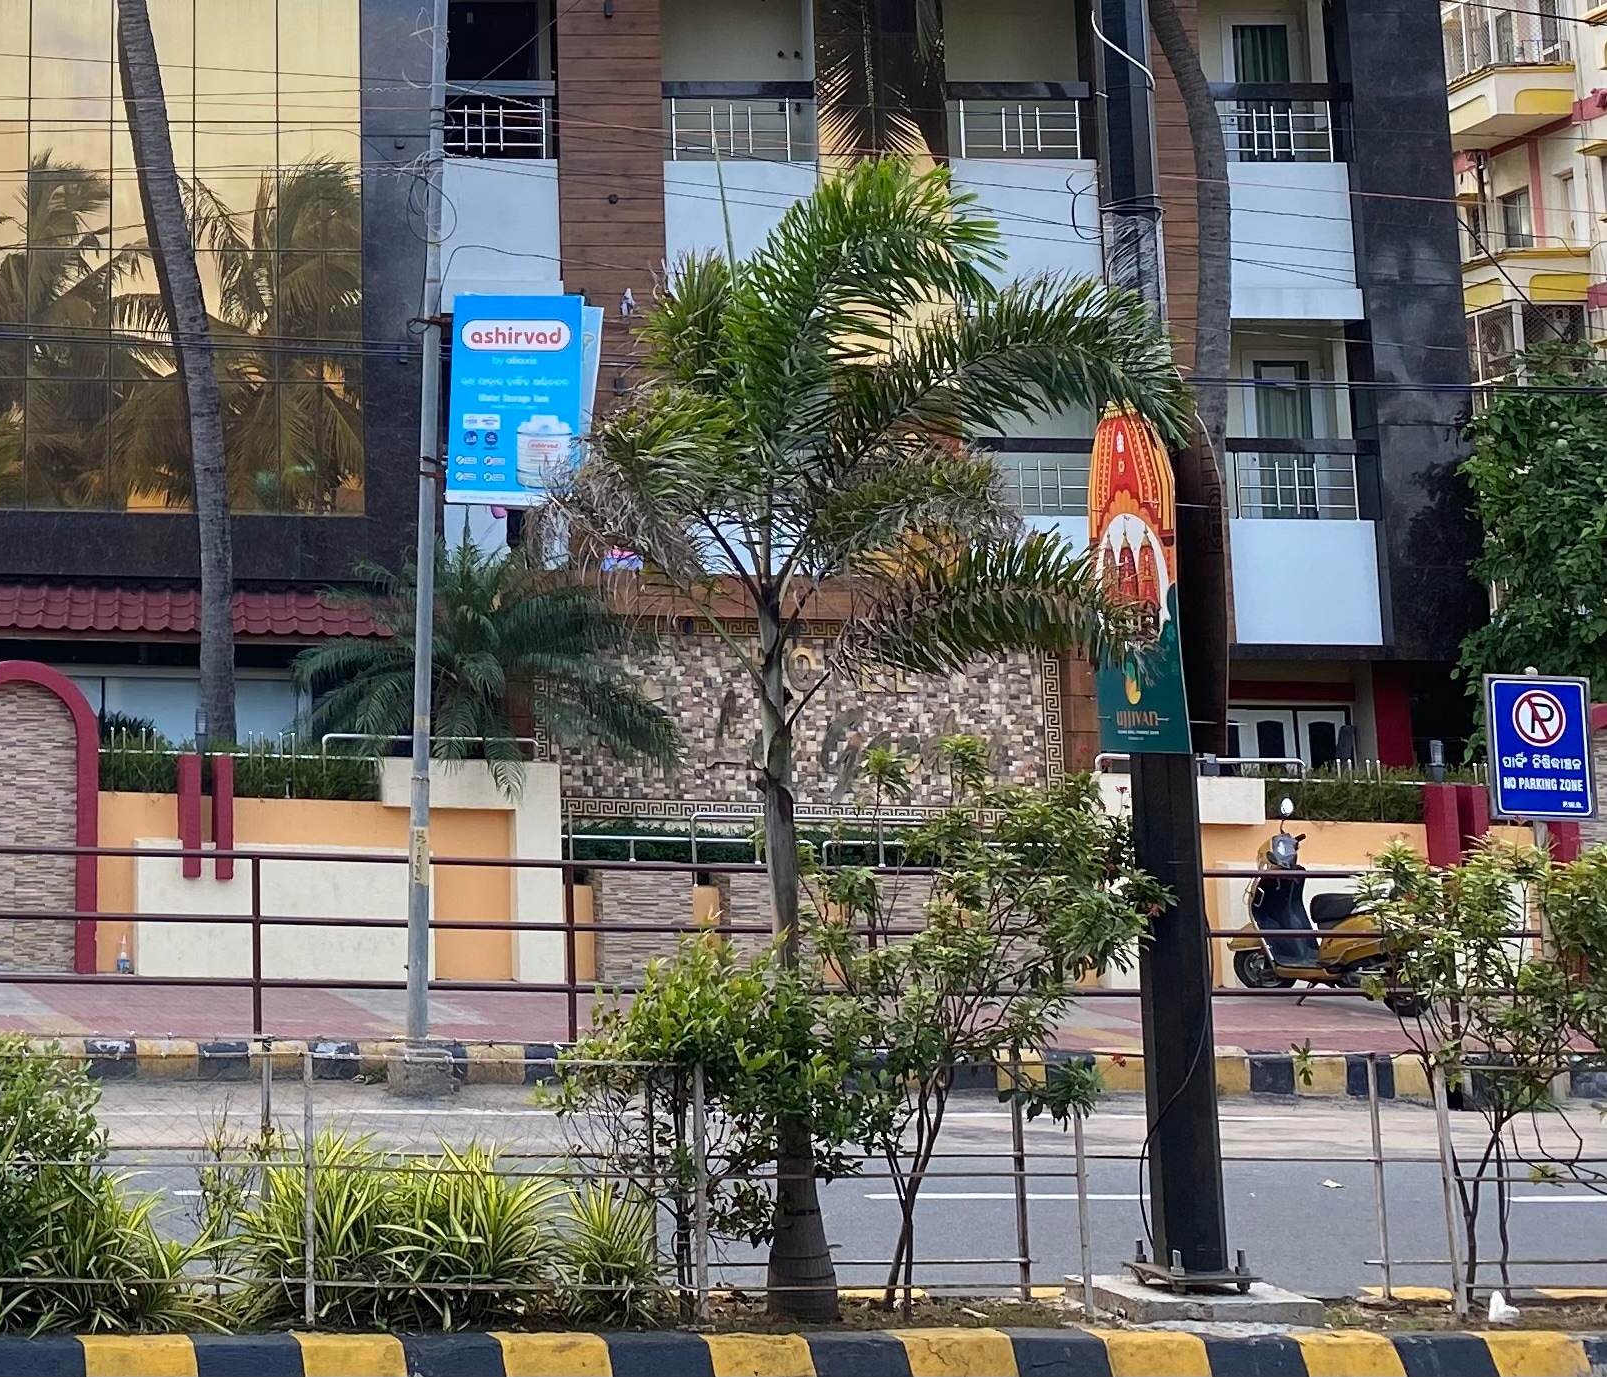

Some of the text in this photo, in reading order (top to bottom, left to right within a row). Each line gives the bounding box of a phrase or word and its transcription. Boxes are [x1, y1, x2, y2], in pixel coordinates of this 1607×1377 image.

[470, 326, 562, 345] ashirvad
[492, 356, 504, 366] by
[530, 441, 559, 449] ashirvad
[1503, 777, 1584, 792] NO PARKING ZONE
